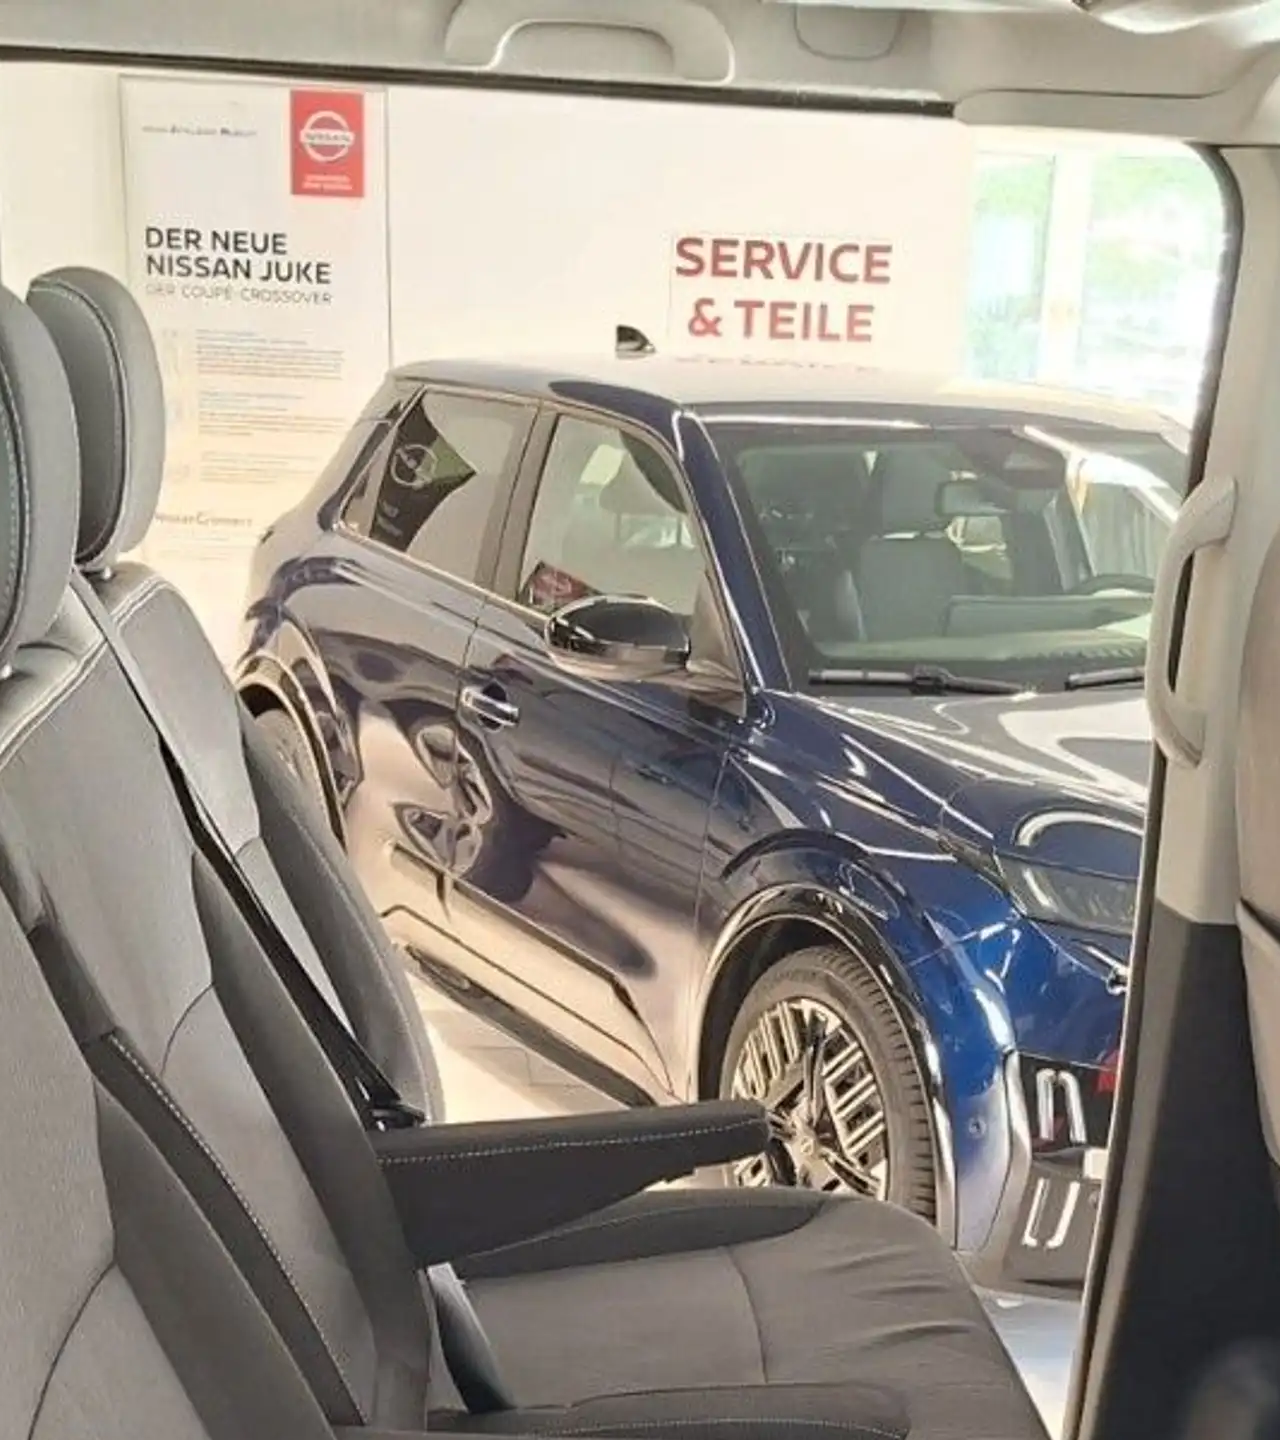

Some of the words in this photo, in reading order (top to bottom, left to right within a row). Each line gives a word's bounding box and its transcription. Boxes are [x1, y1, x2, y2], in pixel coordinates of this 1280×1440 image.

[145, 227, 202, 250] DER
[212, 230, 288, 255] NEUE
[146, 254, 251, 280] NISSAN
[259, 260, 332, 285] JUKE
[675, 237, 893, 285] SERVICE
[687, 297, 723, 338] &
[733, 299, 875, 342] TEILE
